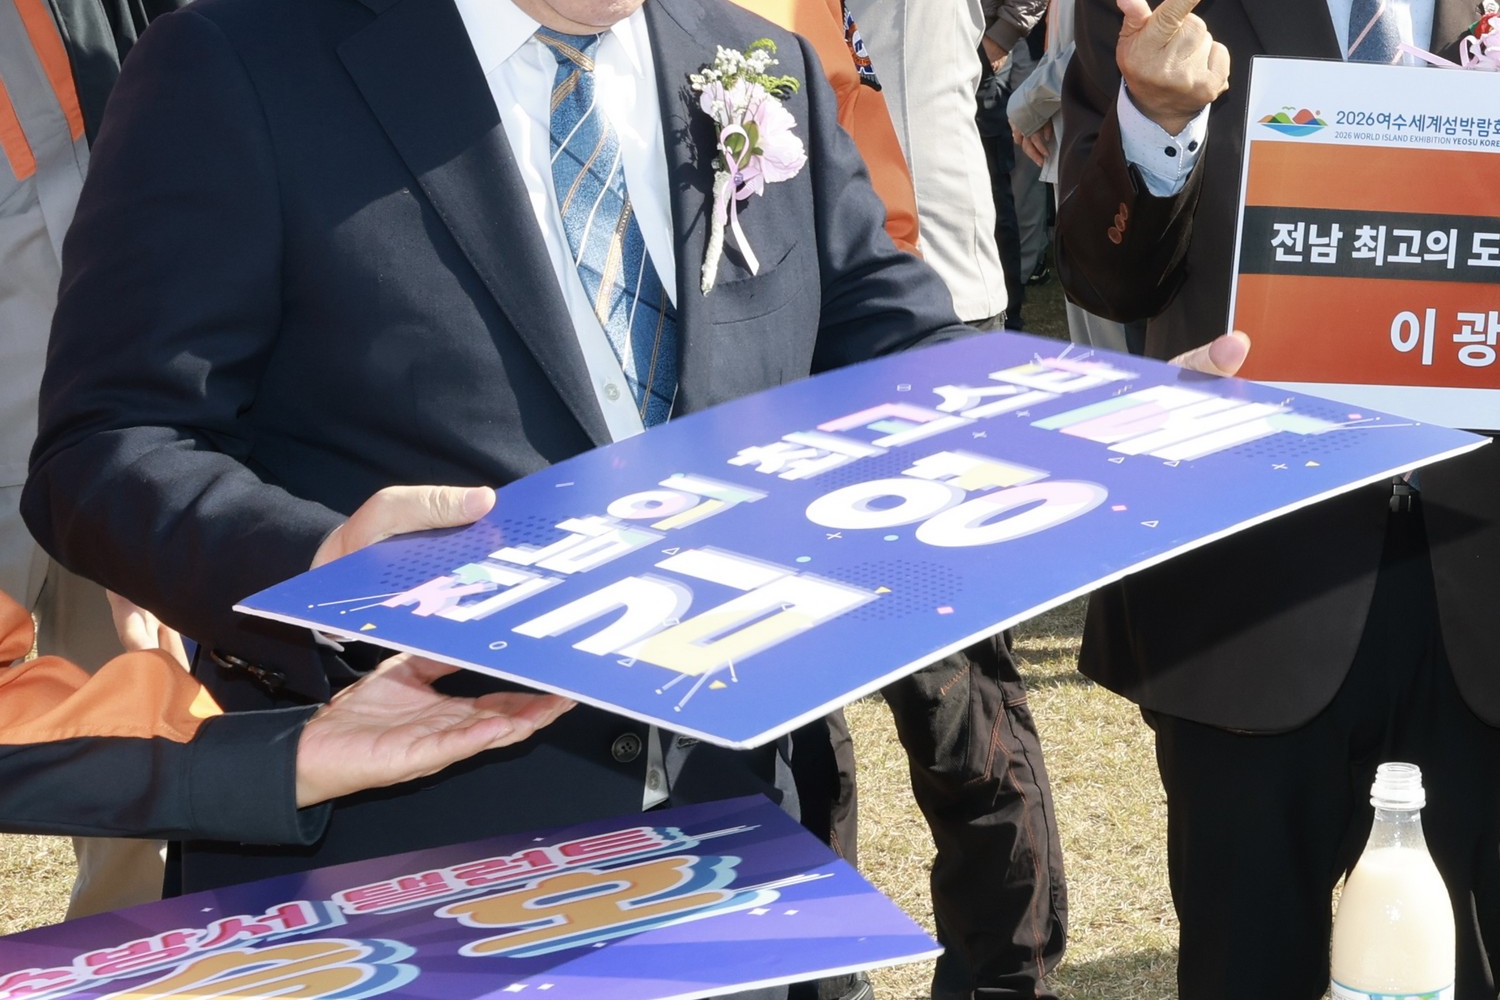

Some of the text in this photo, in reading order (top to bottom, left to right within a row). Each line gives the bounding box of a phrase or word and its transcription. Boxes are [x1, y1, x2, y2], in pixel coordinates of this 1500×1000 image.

[1334, 131, 1353, 140] 2026
[1353, 132, 1381, 142] WORLD
[1381, 134, 1408, 143] ISLAND
[1409, 135, 1452, 145] EXHIBITION
[1452, 137, 1479, 147] YEOSU
[1271, 221, 1344, 264] 전남
[1352, 226, 1458, 270] 최고의
[377, 356, 1140, 623] 전남의 최고스타
[332, 826, 668, 916] 탤런트
